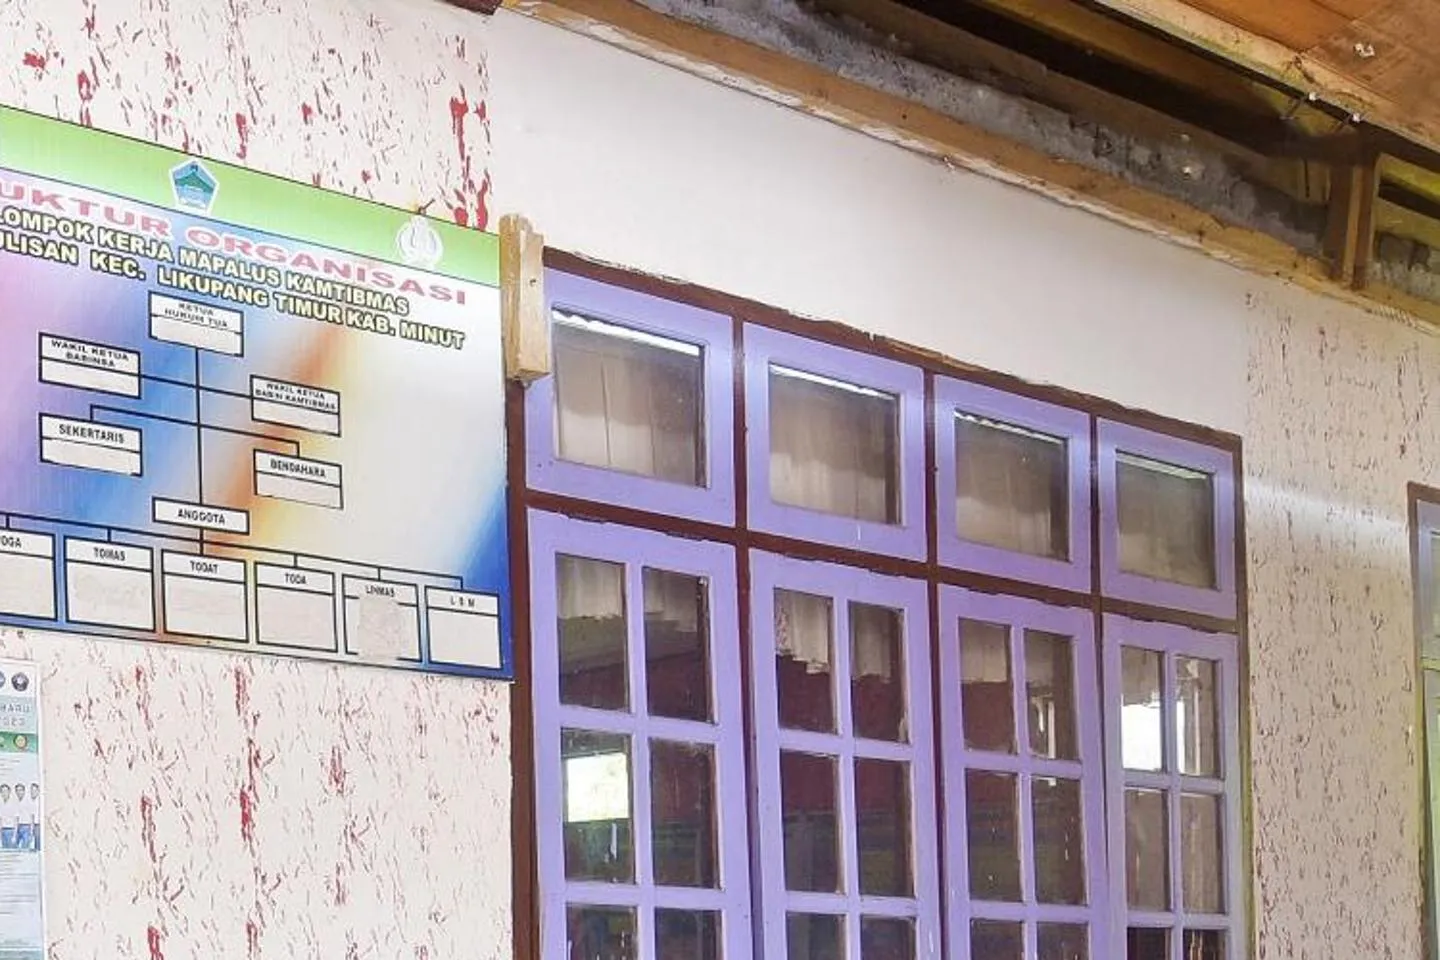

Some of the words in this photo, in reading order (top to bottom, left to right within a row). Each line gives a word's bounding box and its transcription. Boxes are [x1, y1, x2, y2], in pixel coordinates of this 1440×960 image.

[97, 226, 174, 263] KERJA
[178, 245, 281, 288] MAPALUS
[285, 270, 410, 316] KAMTIBMAS
[186, 226, 467, 305] ORGANISASI
[90, 250, 146, 280] KEC.
[157, 266, 268, 308] LIKUPANG
[272, 292, 345, 327] TIMUR
[346, 307, 395, 336] KAB.
[399, 320, 465, 350] MINUT
[178, 302, 214, 316] KETUA
[164, 308, 205, 325] HUKUM
[208, 317, 228, 328] TUA
[51, 339, 88, 354] WAKIL
[91, 347, 129, 362] KETUA
[65, 352, 116, 368] BABINSA
[59, 424, 125, 444] SEKERTARIS
[270, 458, 327, 479] BENDAHARA
[178, 508, 226, 525] ANGGOTA
[93, 547, 126, 562] TOMAS
[365, 585, 395, 598] LINMAS
